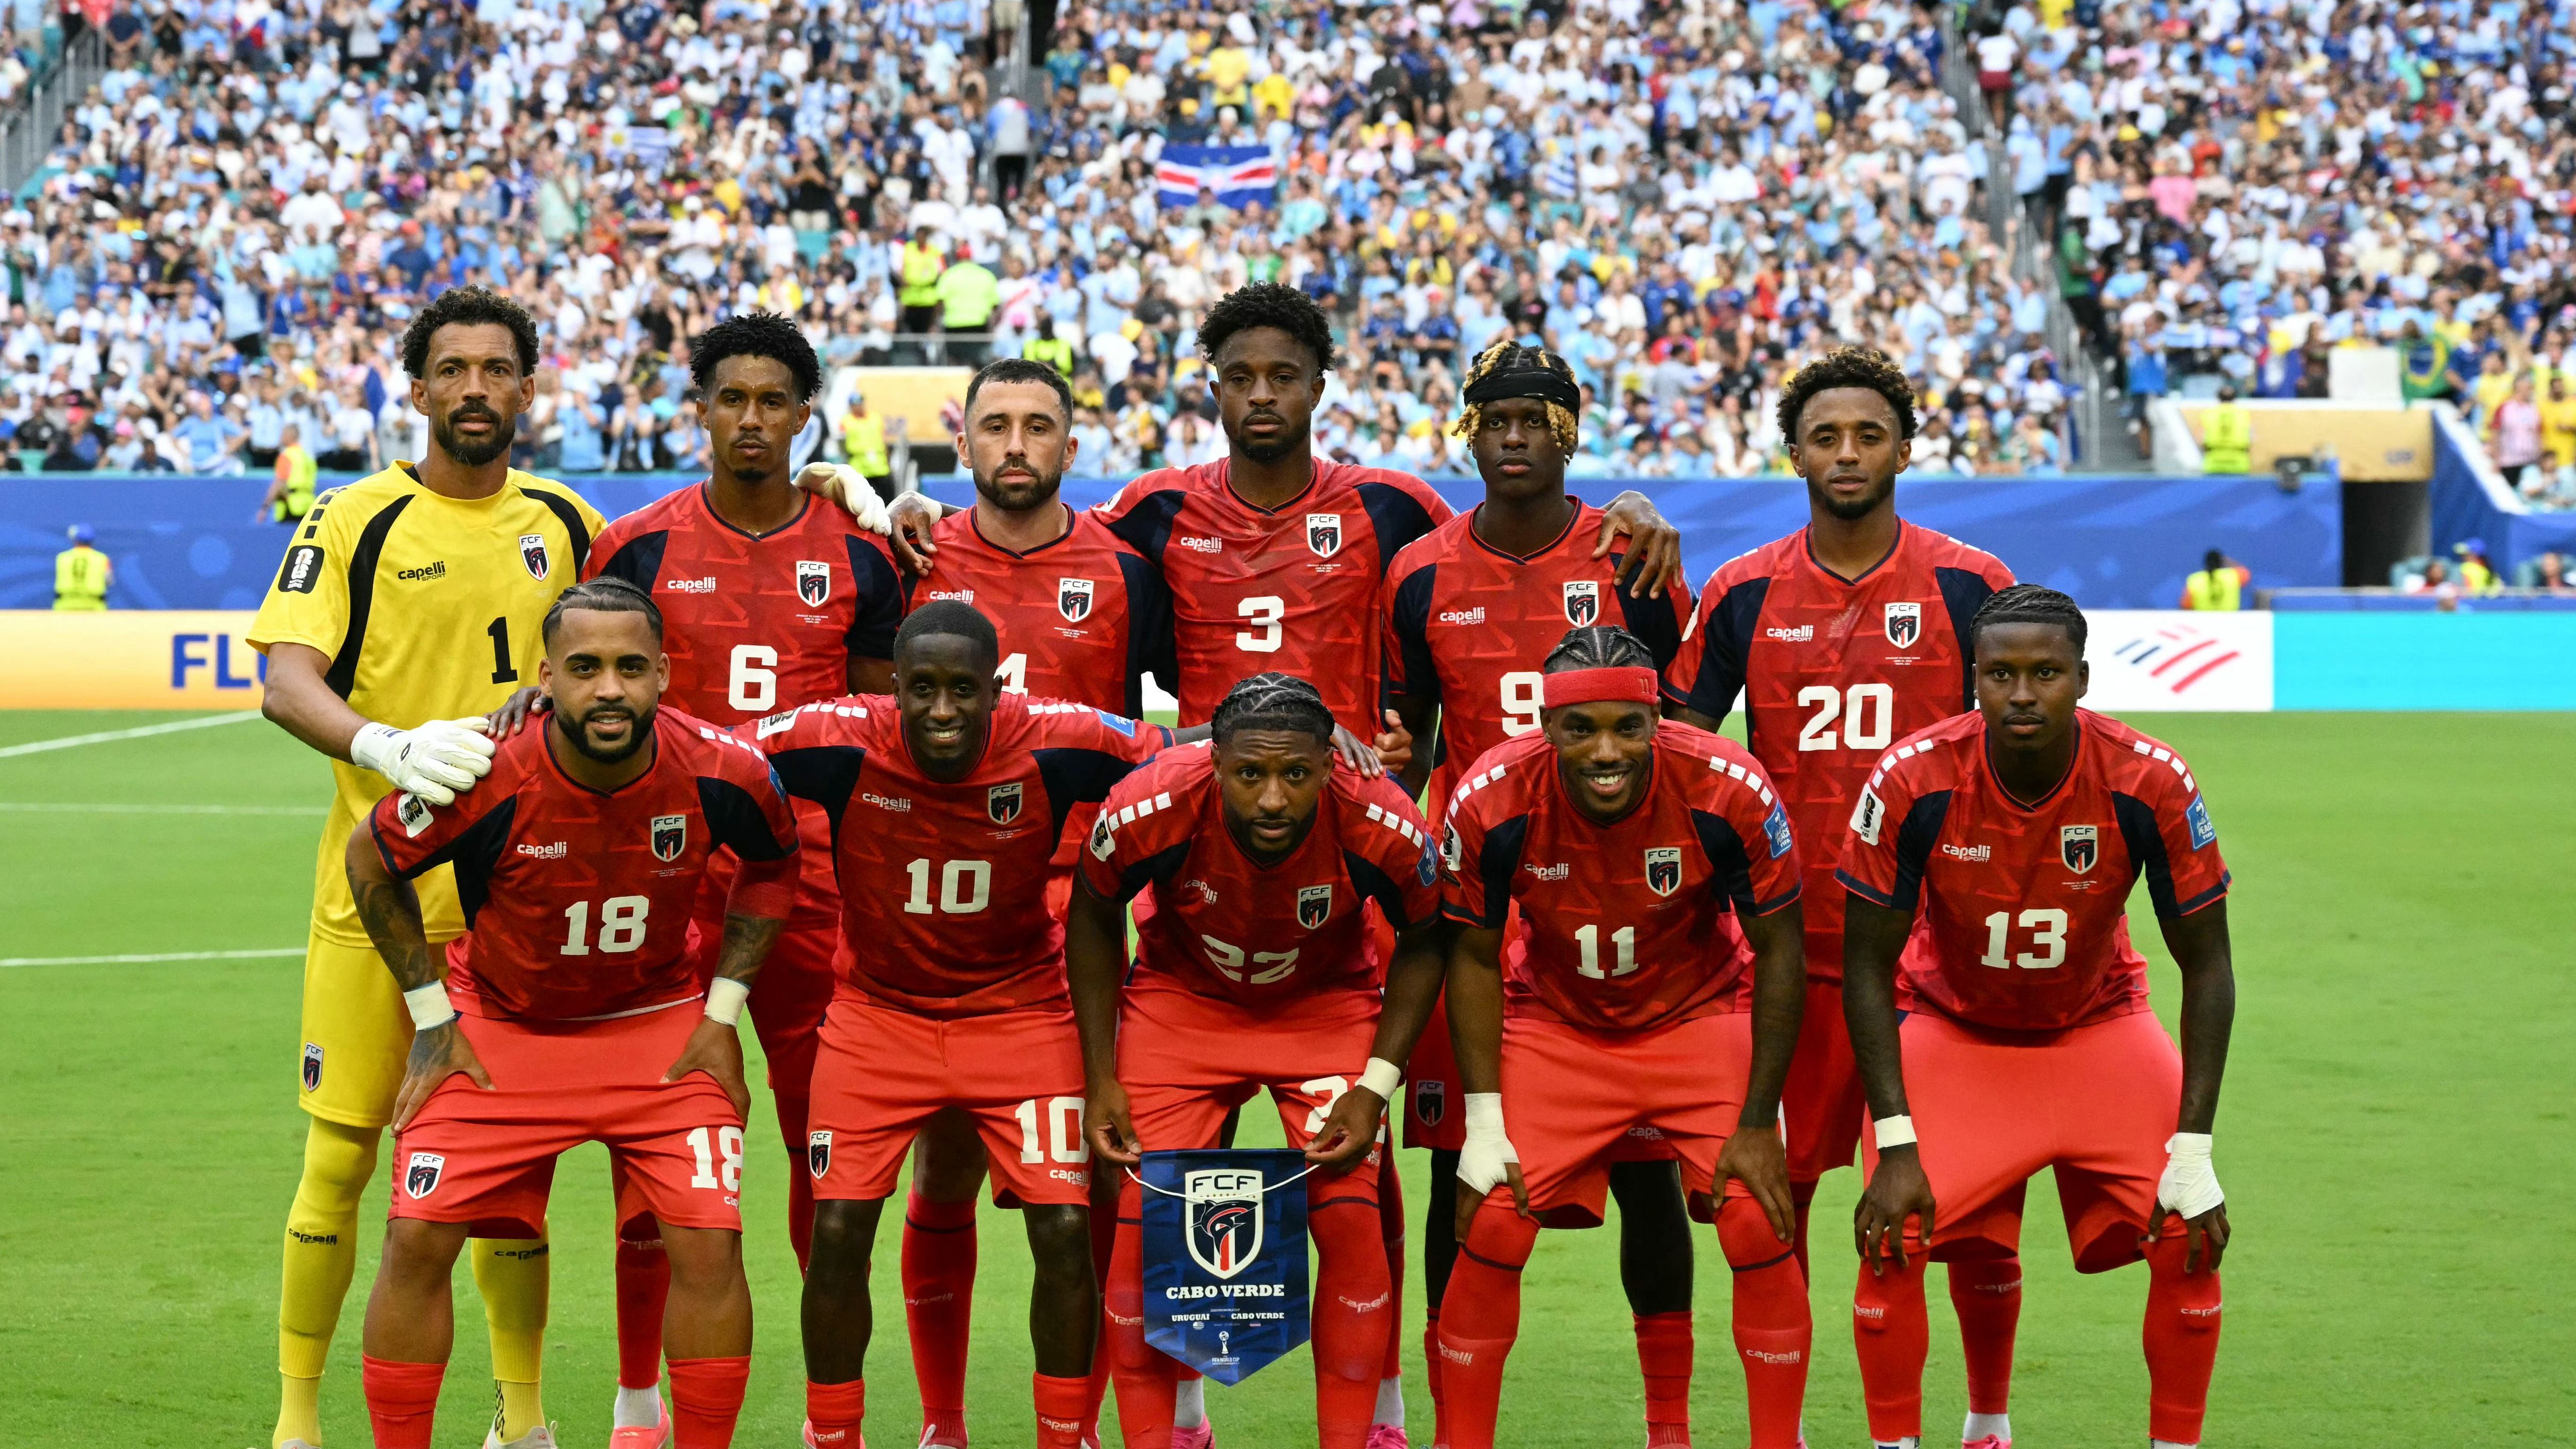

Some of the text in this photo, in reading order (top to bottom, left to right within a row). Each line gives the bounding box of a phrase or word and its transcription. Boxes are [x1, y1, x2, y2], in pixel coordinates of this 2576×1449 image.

[521, 536, 540, 545] FCF
[1180, 537, 1222, 553] capelli
[398, 561, 446, 581] capelli
[422, 573, 446, 581] SPORT
[667, 577, 716, 593] capelli
[1235, 595, 1285, 653] 3
[1440, 607, 1486, 625] capelli
[1766, 625, 1814, 641] capelli
[487, 616, 518, 684] 1
[728, 645, 778, 711] 6
[1500, 671, 1545, 738] 9
[1798, 683, 1893, 752] 20
[991, 785, 1019, 795] FCF
[862, 793, 911, 810] capelli
[654, 817, 682, 827] FCF
[2064, 827, 2093, 836] FCF
[517, 842, 568, 859] capelli
[1647, 850, 1678, 859] FCF
[1942, 844, 1990, 861] capelli
[1524, 863, 1569, 880] capelli
[904, 858, 992, 914] 10
[1300, 887, 1330, 897] FCF
[560, 895, 650, 955] 18
[1981, 908, 2068, 969] 13
[1201, 934, 1300, 984] 22
[1575, 924, 1639, 980] 11
[305, 1044, 322, 1055] FCF
[1015, 1096, 1089, 1164] 10
[413, 1155, 442, 1165] FCF
[686, 1126, 744, 1192] 18
[1050, 1169, 1089, 1184] capelli
[1192, 1175, 1257, 1193] FCF
[288, 1228, 337, 1243] capelli
[1166, 1284, 1285, 1299] CABO VERDE
[1172, 1313, 1210, 1322] URUGUAI
[1746, 1349, 1800, 1363] capelli
[1041, 1417, 1080, 1430] capelli
[813, 1429, 845, 1442] apelli
